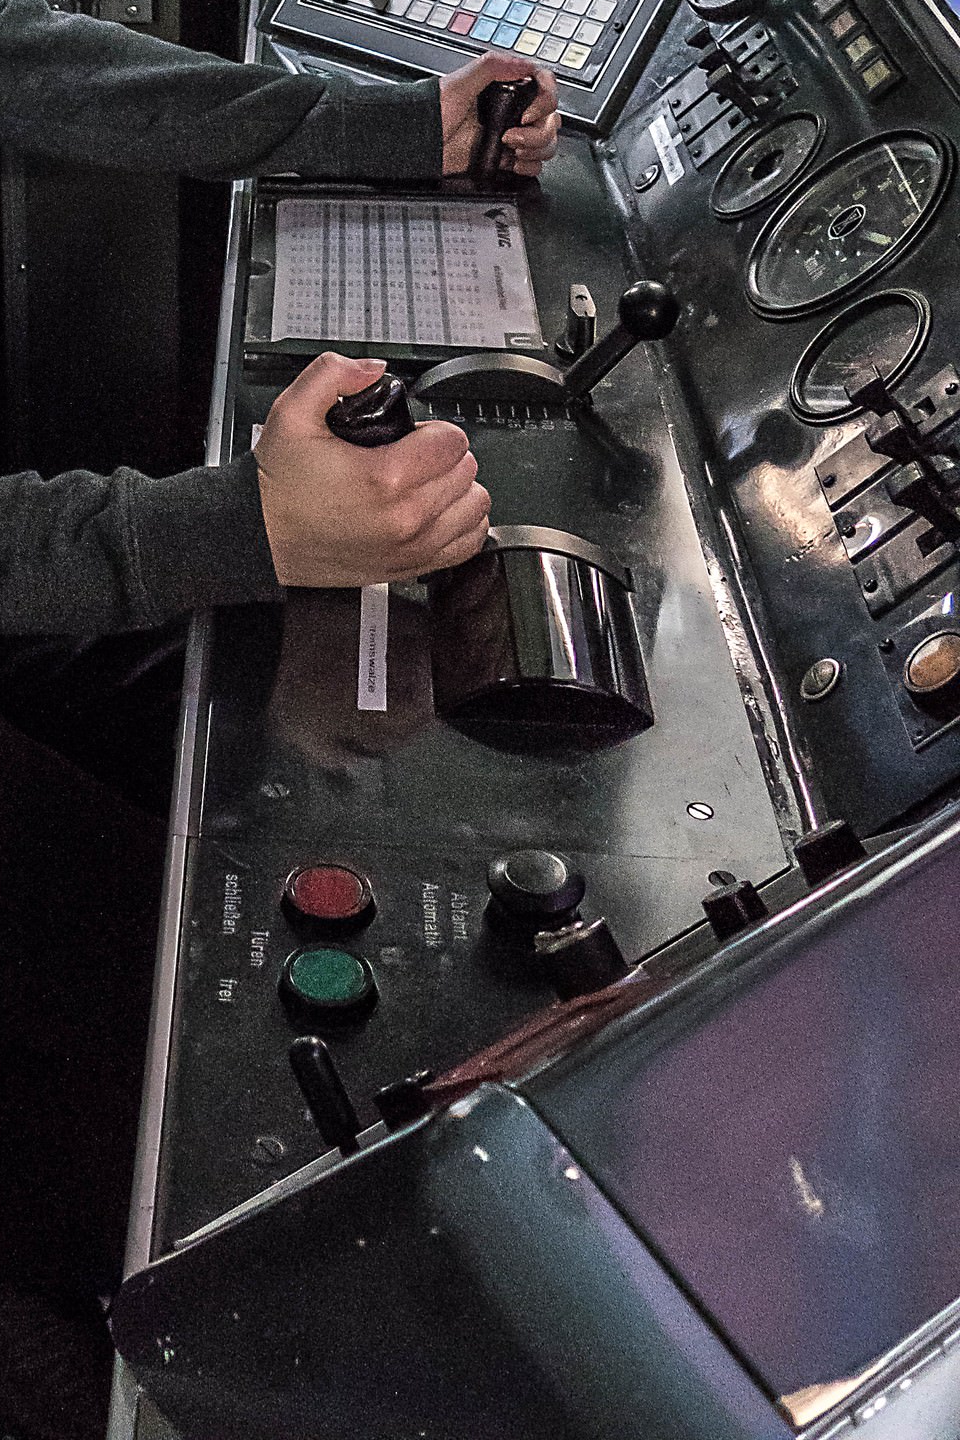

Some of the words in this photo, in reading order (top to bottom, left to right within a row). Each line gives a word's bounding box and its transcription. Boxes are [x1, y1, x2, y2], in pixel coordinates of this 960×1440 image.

[495, 220, 511, 249] MVG
[223, 874, 242, 935] schließen
[421, 882, 443, 948] Automatik
[450, 891, 469, 940] Abfahrt
[250, 930, 269, 967] Türen
[218, 978, 238, 1002] frei
